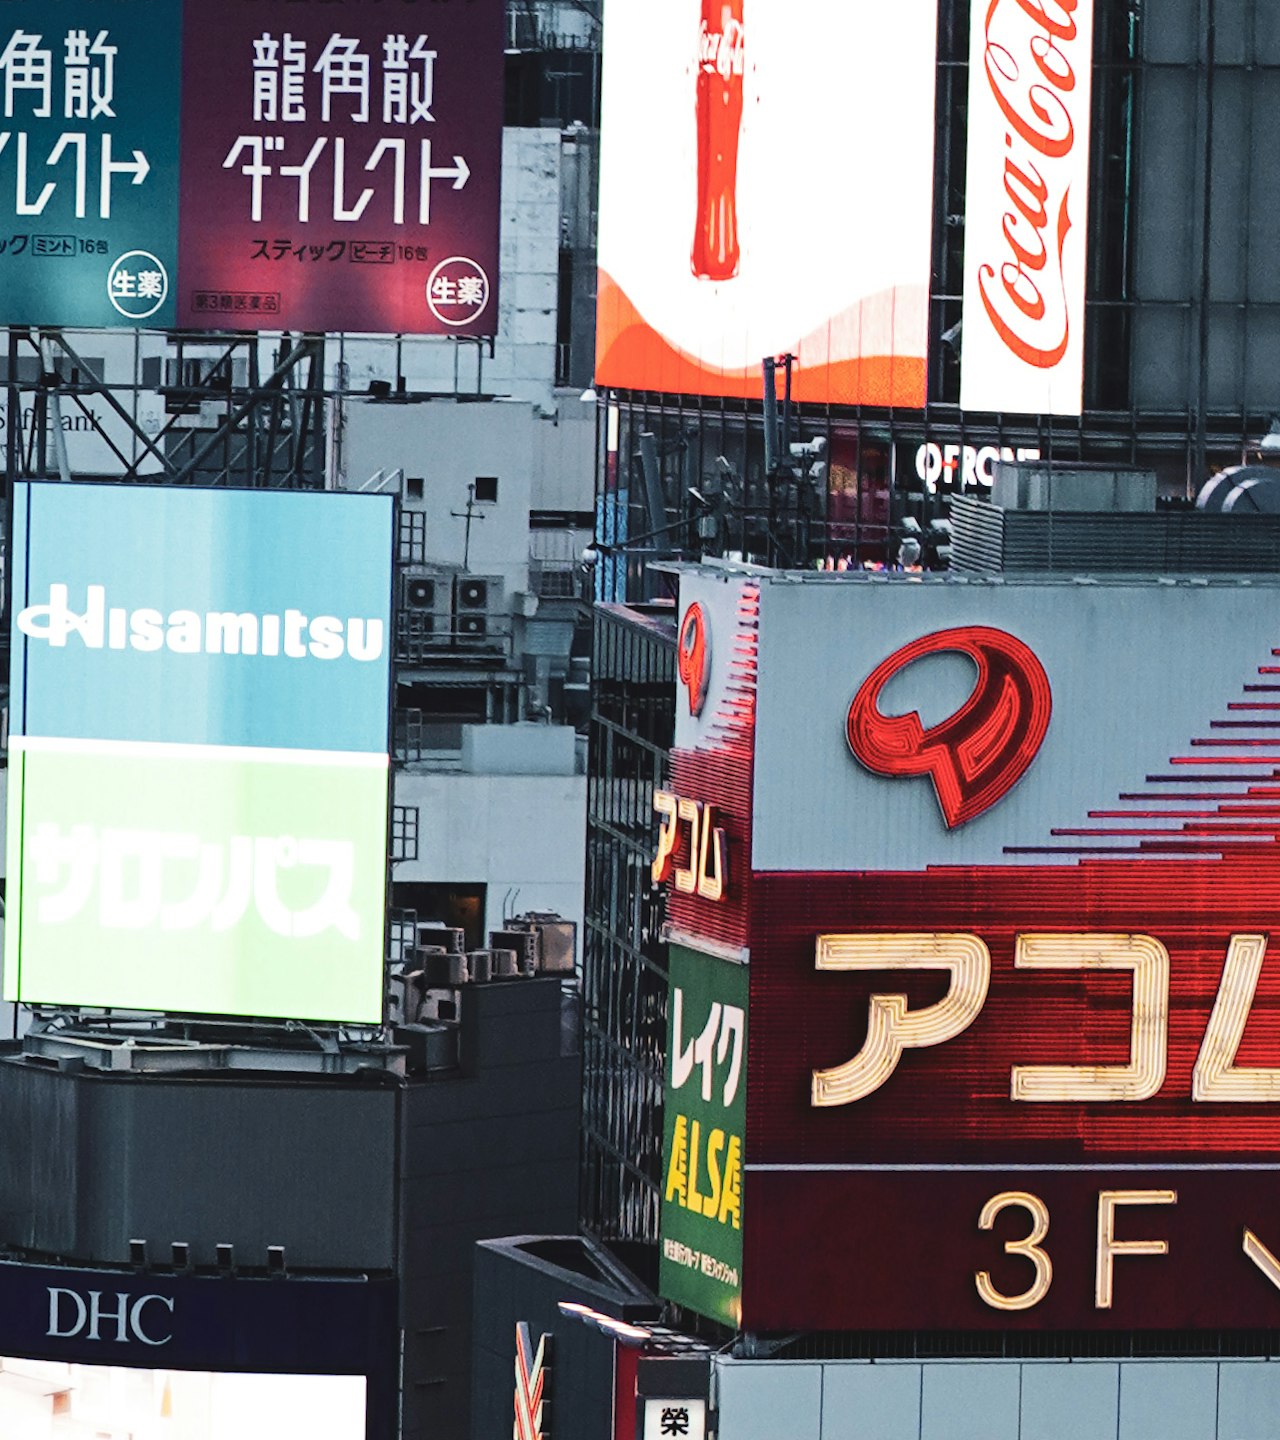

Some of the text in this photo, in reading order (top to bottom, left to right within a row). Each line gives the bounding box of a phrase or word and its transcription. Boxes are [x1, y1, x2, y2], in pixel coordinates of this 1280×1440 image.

[252, 32, 438, 126] 龍角散
[222, 134, 472, 225] ダイレクト
[34, 236, 75, 256] ミント
[111, 268, 163, 300] 生薬
[251, 238, 345, 263] スティック
[431, 275, 484, 307] 生薬
[17, 583, 384, 662] Hisamitsu
[30, 821, 360, 940] サロンパス
[650, 789, 725, 901] アコム
[671, 987, 745, 1107] レイク
[665, 1113, 742, 1232] ALSA
[975, 1188, 1179, 1311] 3F
[46, 1286, 175, 1346] DHC
